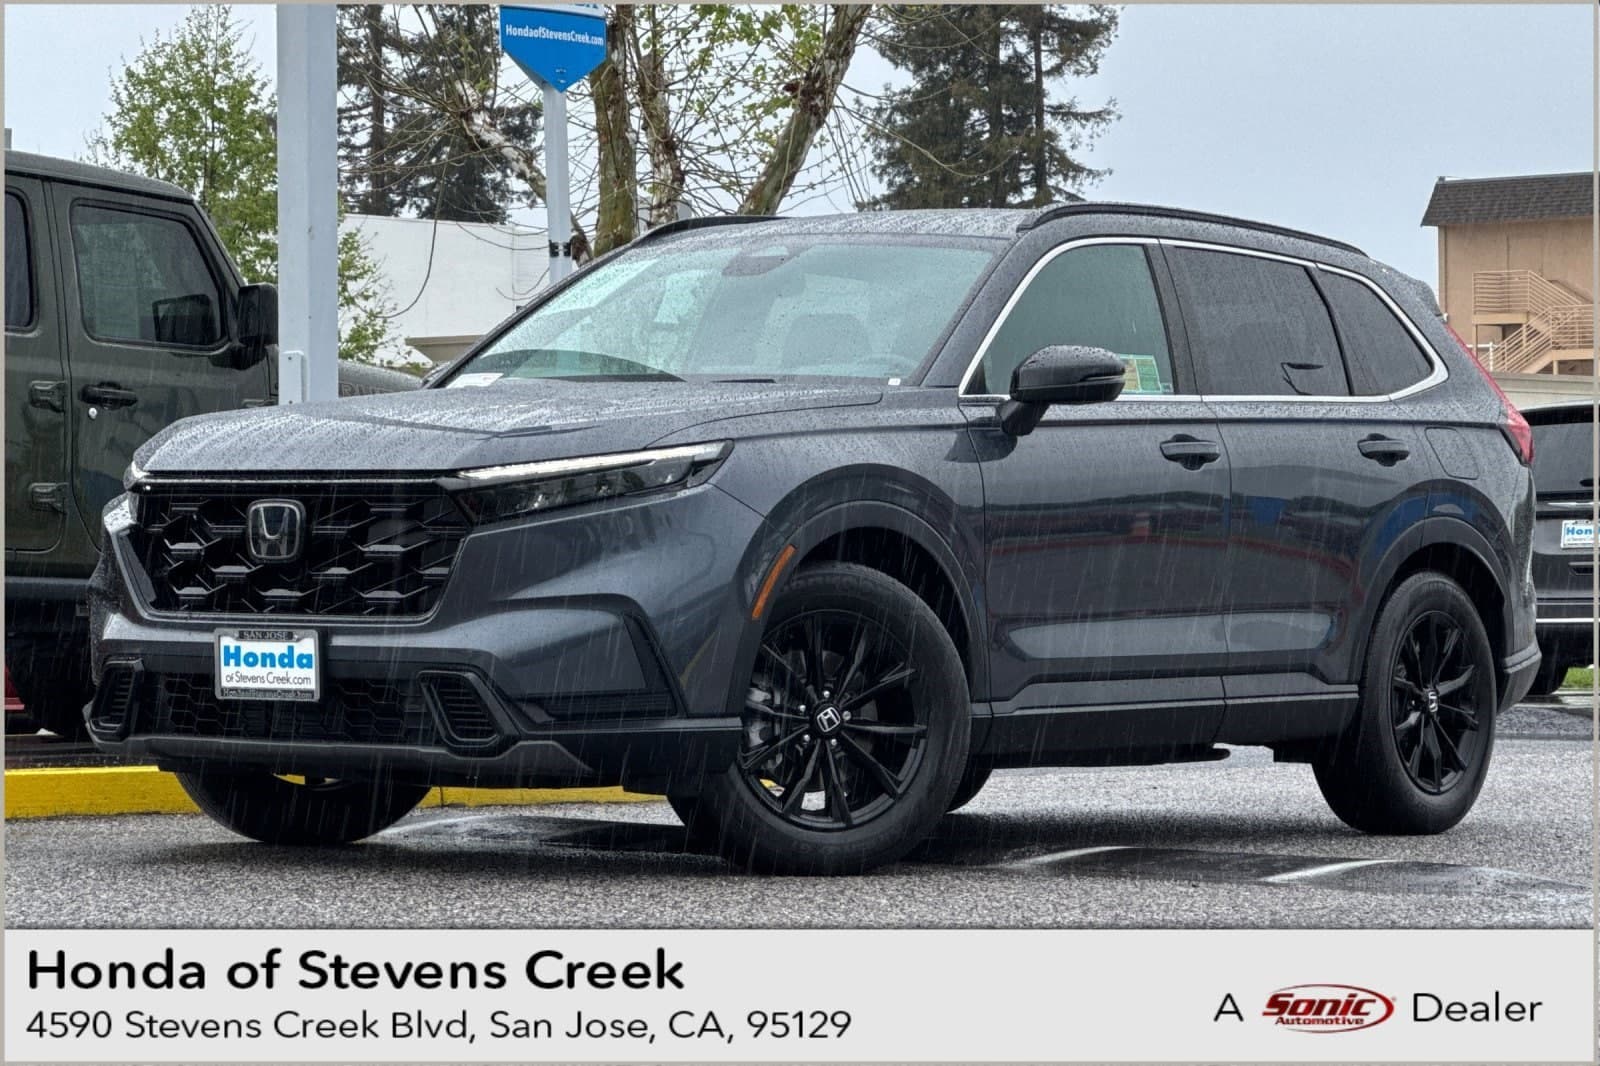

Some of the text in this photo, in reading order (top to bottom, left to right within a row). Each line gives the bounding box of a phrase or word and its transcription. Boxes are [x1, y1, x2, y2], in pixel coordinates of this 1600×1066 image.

[505, 24, 604, 46] HondaofStevensCreek.com
[1566, 526, 1593, 536] Hon
[243, 630, 289, 640] SAN JOSE
[223, 645, 313, 669] Honda
[225, 671, 312, 686] of Stevens Creek.com
